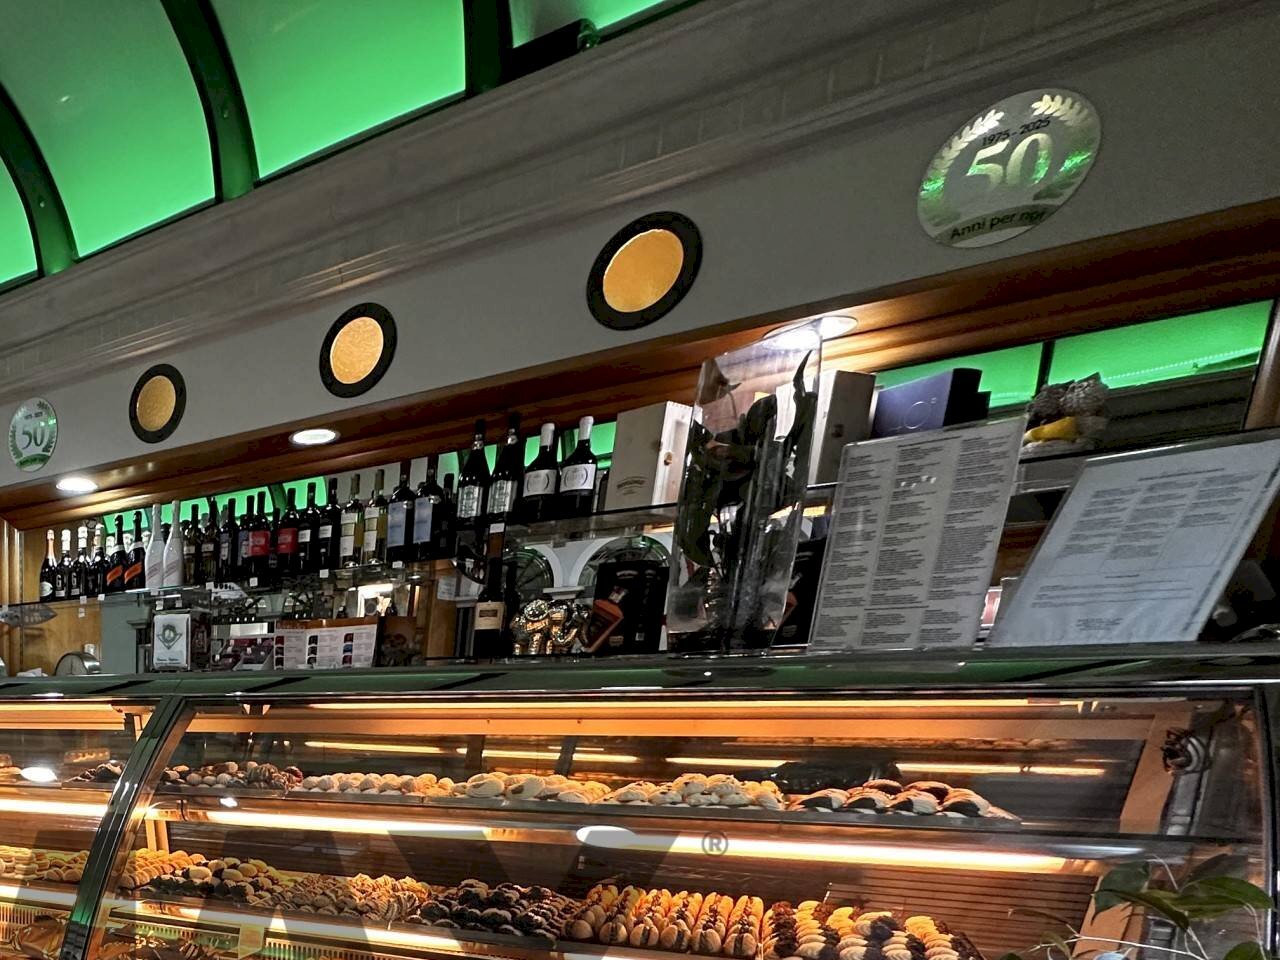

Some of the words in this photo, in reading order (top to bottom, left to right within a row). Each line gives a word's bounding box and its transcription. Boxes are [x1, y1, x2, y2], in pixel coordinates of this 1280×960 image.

[983, 130, 1010, 146] 1975
[966, 133, 1052, 190] 50
[950, 217, 986, 239] Anni
[989, 213, 1017, 229] per
[21, 425, 45, 450] 50
